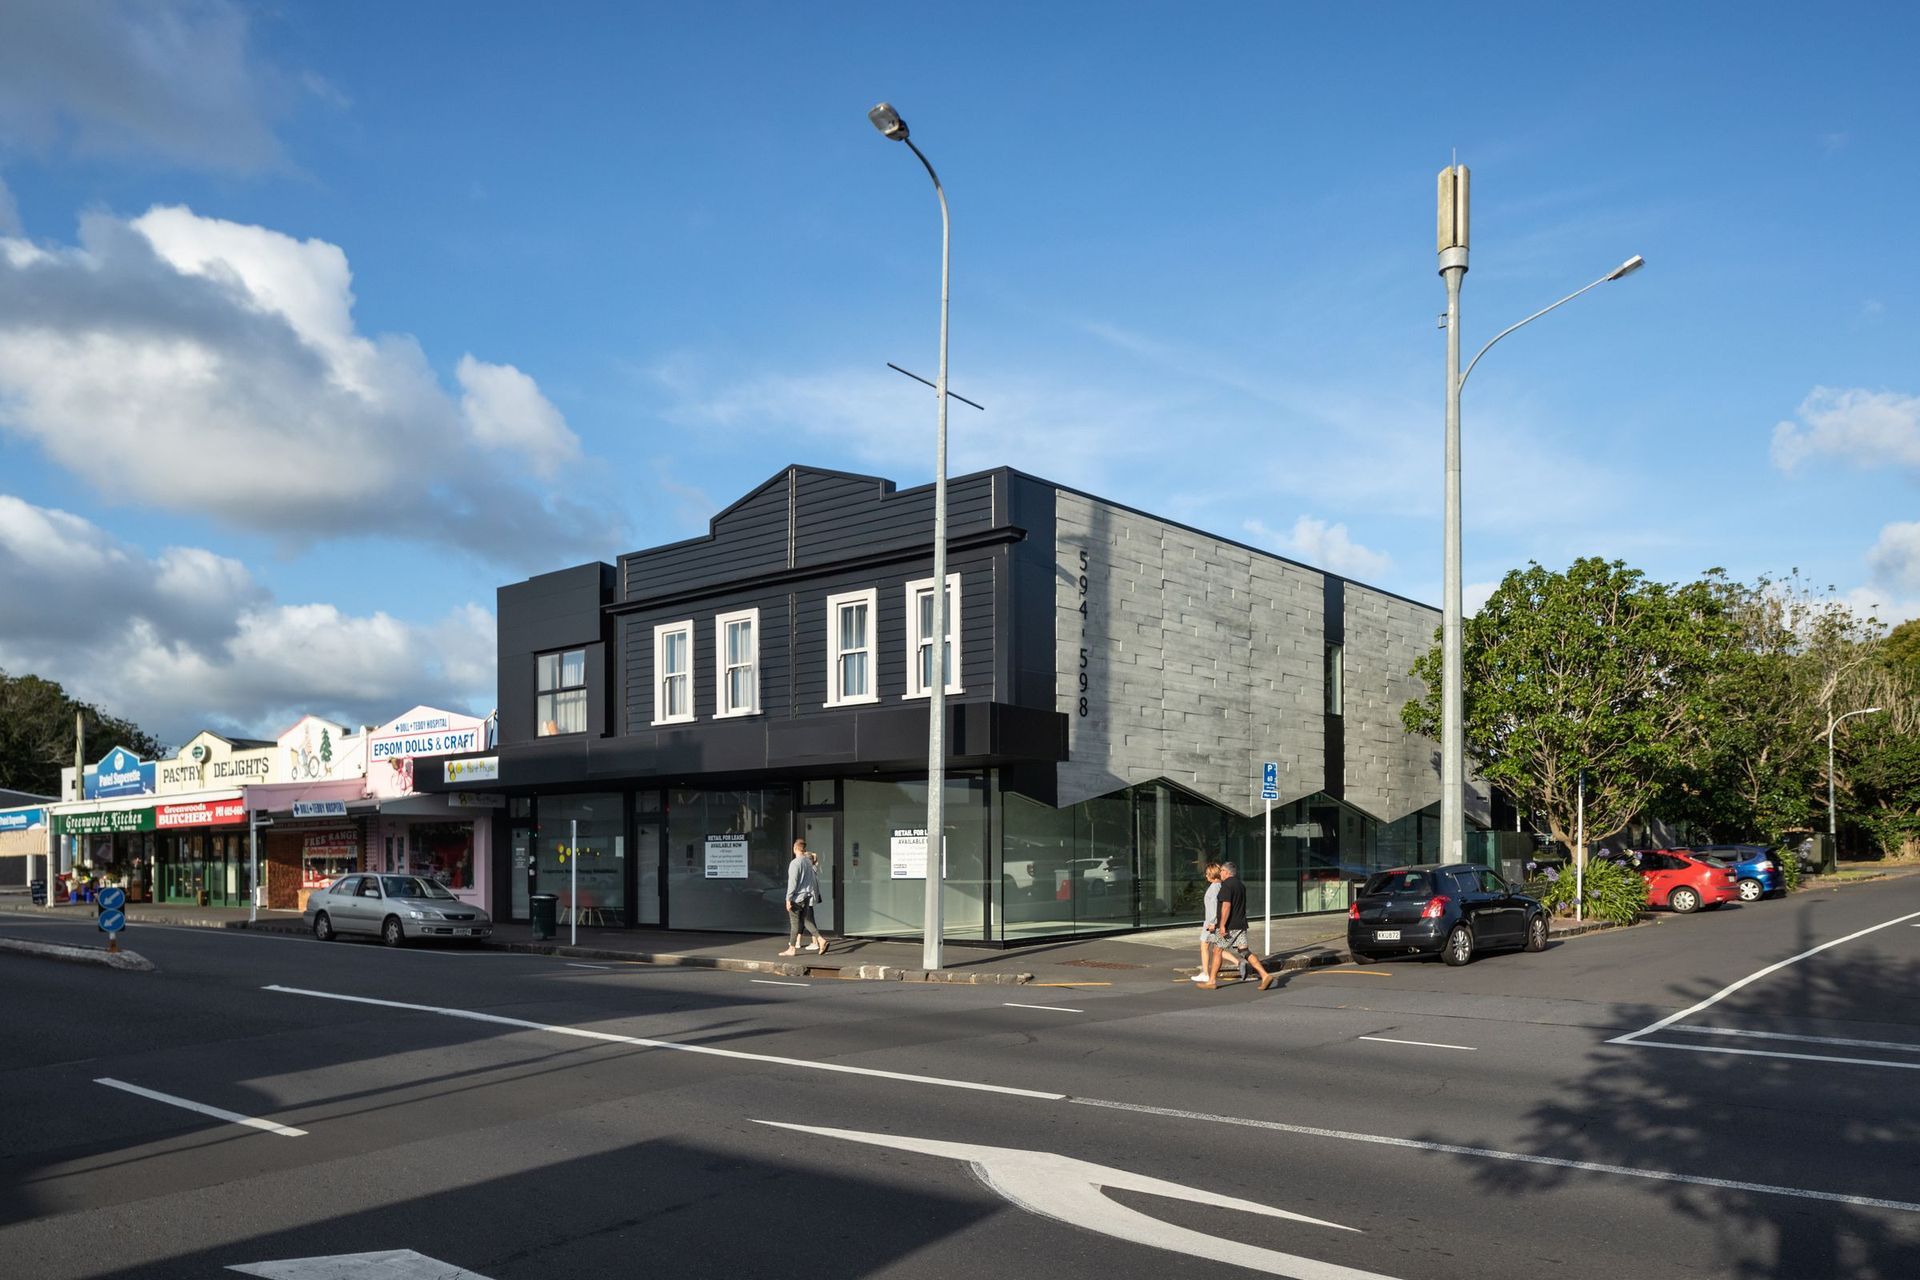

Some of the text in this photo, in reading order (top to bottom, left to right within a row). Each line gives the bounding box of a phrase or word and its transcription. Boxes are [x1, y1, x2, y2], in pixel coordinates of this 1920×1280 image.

[427, 718, 447, 729] HOSPITAL
[374, 733, 474, 757] EPSOM DOLLS & CRAFT
[163, 757, 269, 784] PASTRY DELIGHTS
[164, 803, 206, 814] Greenwoods
[66, 810, 142, 832] Greenwoods Kitchen
[159, 812, 213, 825] BUTCHERY
[305, 835, 327, 847] FREE
[328, 830, 358, 841] RANGE
